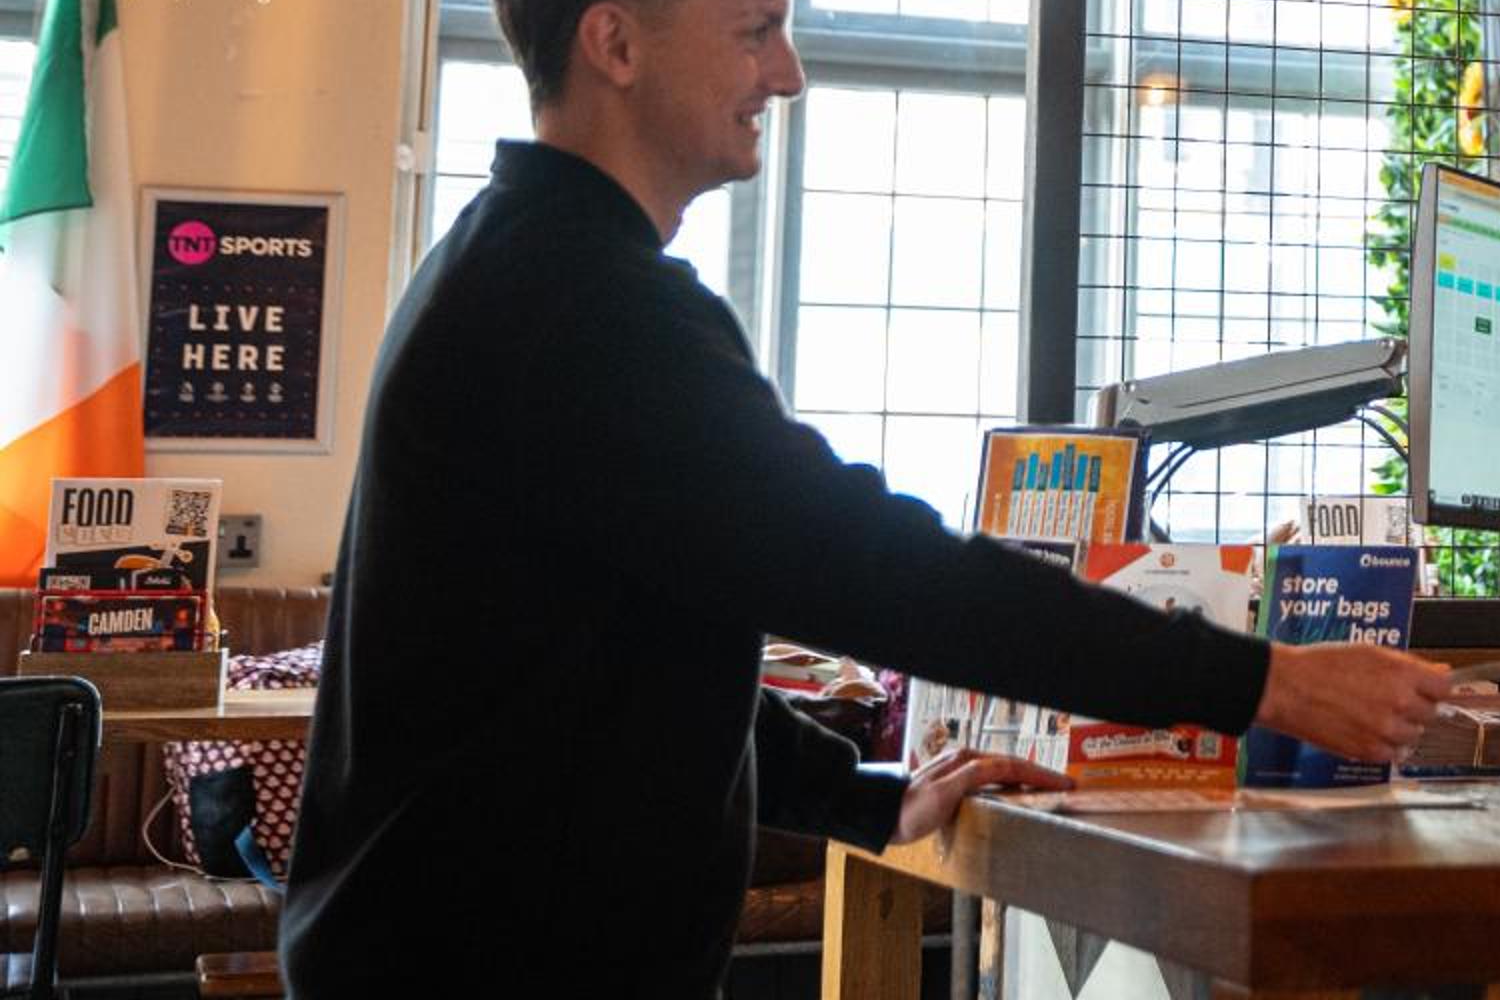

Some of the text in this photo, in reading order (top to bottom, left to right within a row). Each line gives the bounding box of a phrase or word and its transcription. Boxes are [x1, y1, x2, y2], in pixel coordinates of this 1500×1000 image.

[169, 235, 313, 258] TNT SPORTS
[188, 303, 285, 332] LIVE
[182, 343, 286, 372] HERE
[61, 487, 134, 527] FOOD
[1307, 503, 1360, 537] FOOD
[1282, 574, 1340, 594] store
[87, 606, 154, 636] CAMDEN
[1279, 595, 1391, 622] your bags
[1349, 623, 1401, 645] here
